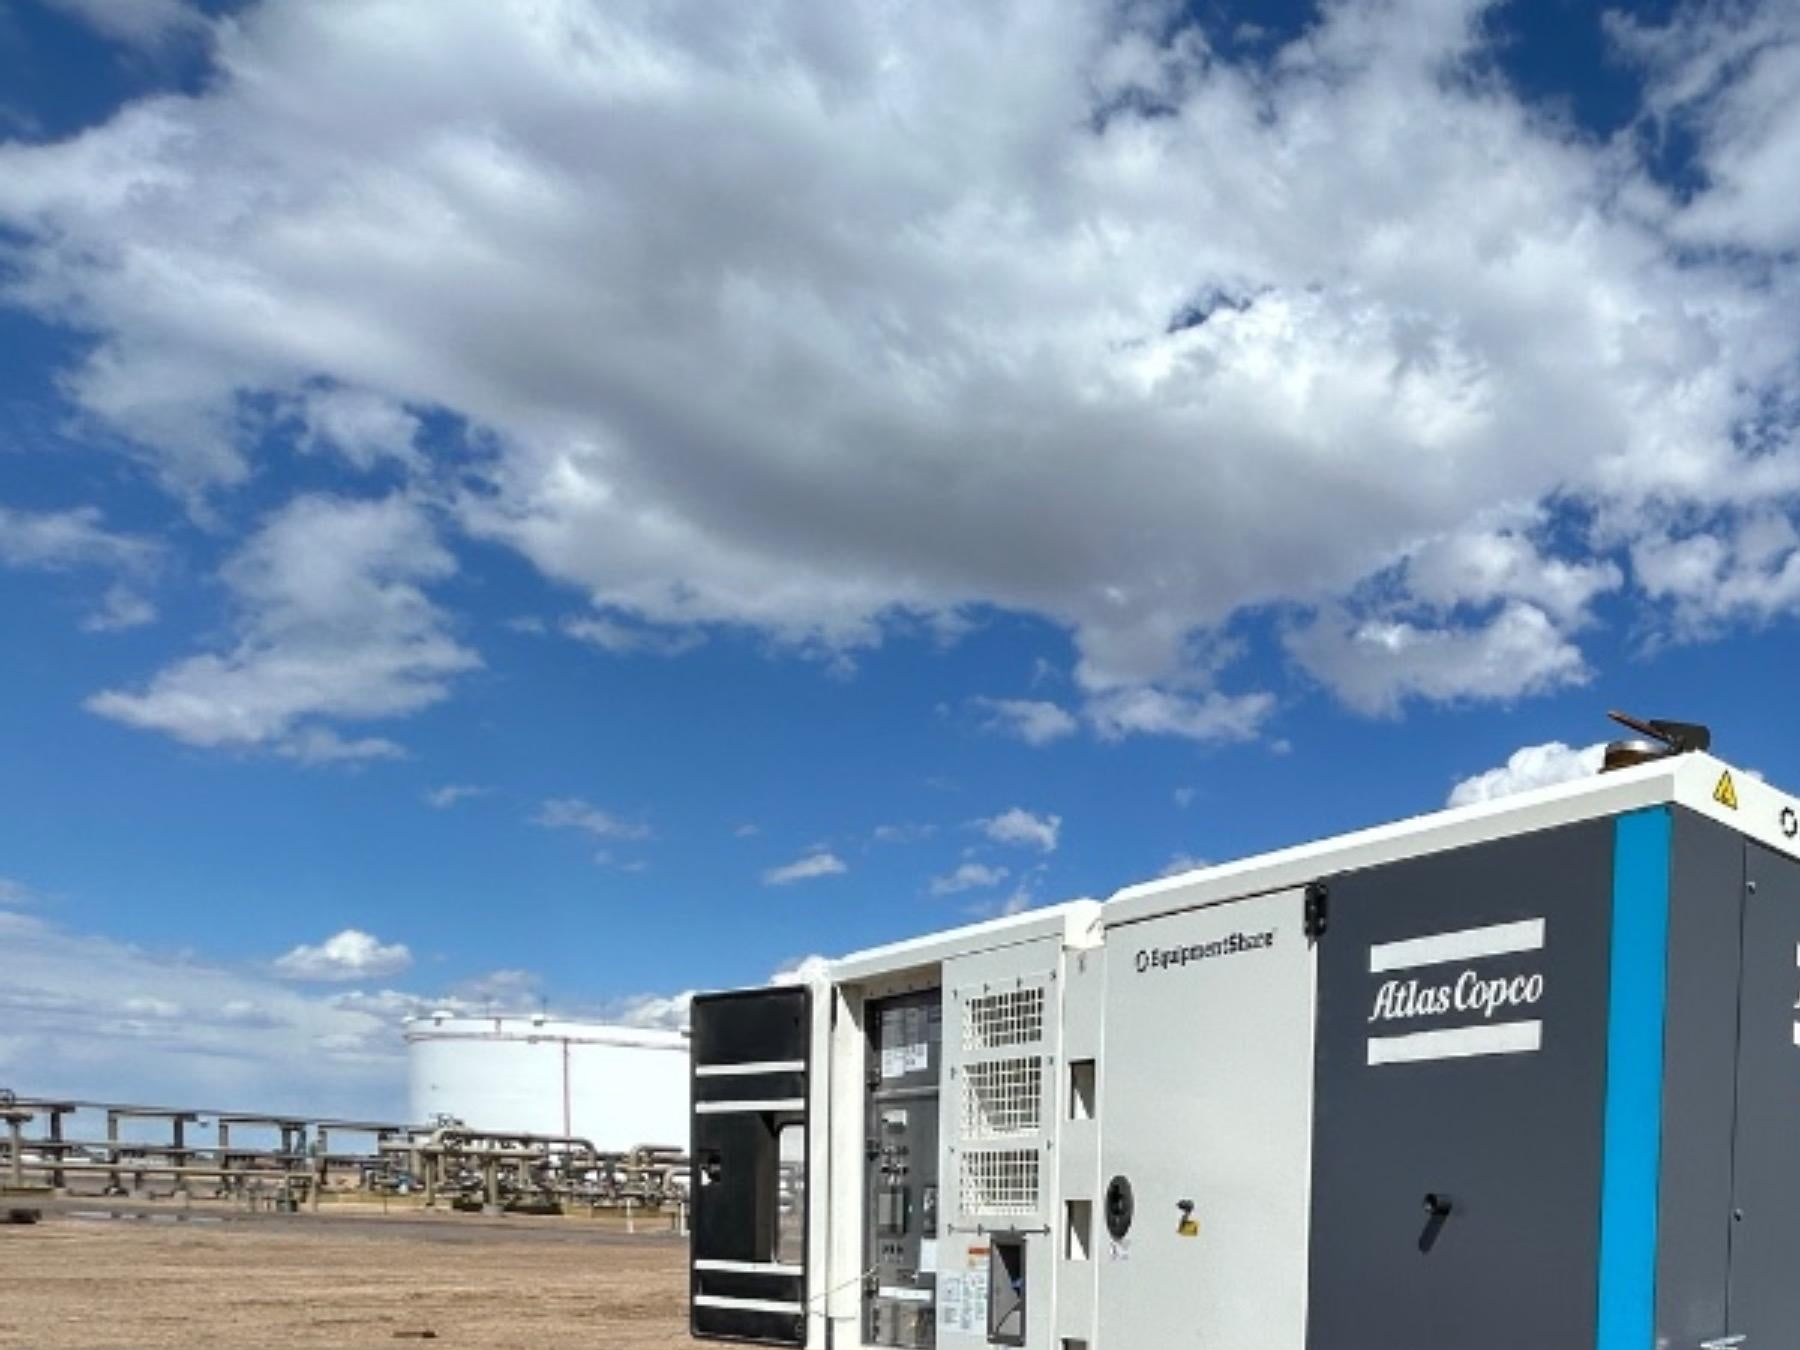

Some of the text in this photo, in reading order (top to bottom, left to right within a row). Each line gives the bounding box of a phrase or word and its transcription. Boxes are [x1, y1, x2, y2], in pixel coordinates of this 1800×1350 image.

[1151, 931, 1273, 969] EquipmentShare
[1368, 970, 1543, 1023] Atlas Copco
